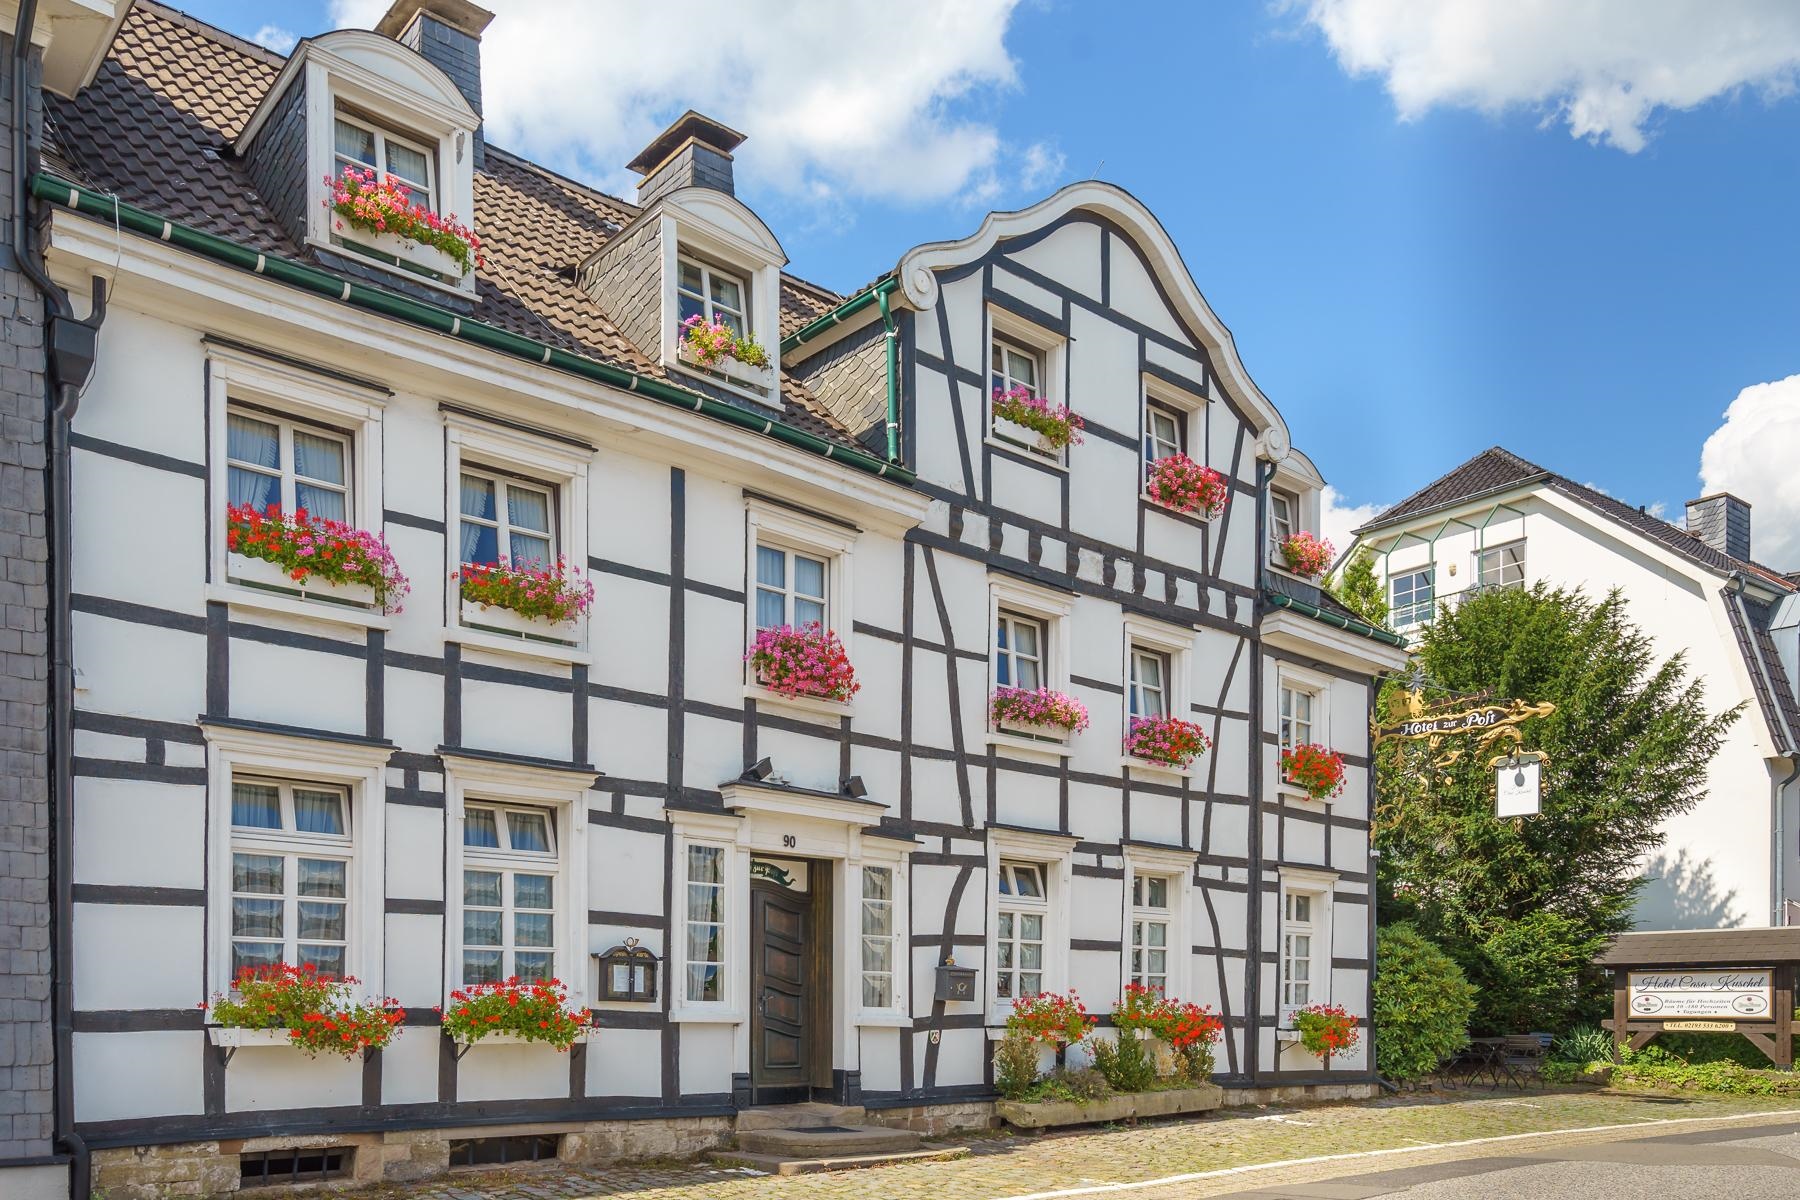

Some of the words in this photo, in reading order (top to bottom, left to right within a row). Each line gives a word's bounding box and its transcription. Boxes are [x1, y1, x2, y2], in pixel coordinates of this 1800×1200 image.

[1400, 720, 1438, 736] Hotel
[1443, 720, 1458, 729] zur
[783, 834, 796, 848] 90
[1635, 975, 1677, 991] Hotel
[1678, 975, 1707, 990] Casa
[1710, 974, 1764, 991] Kuschel
